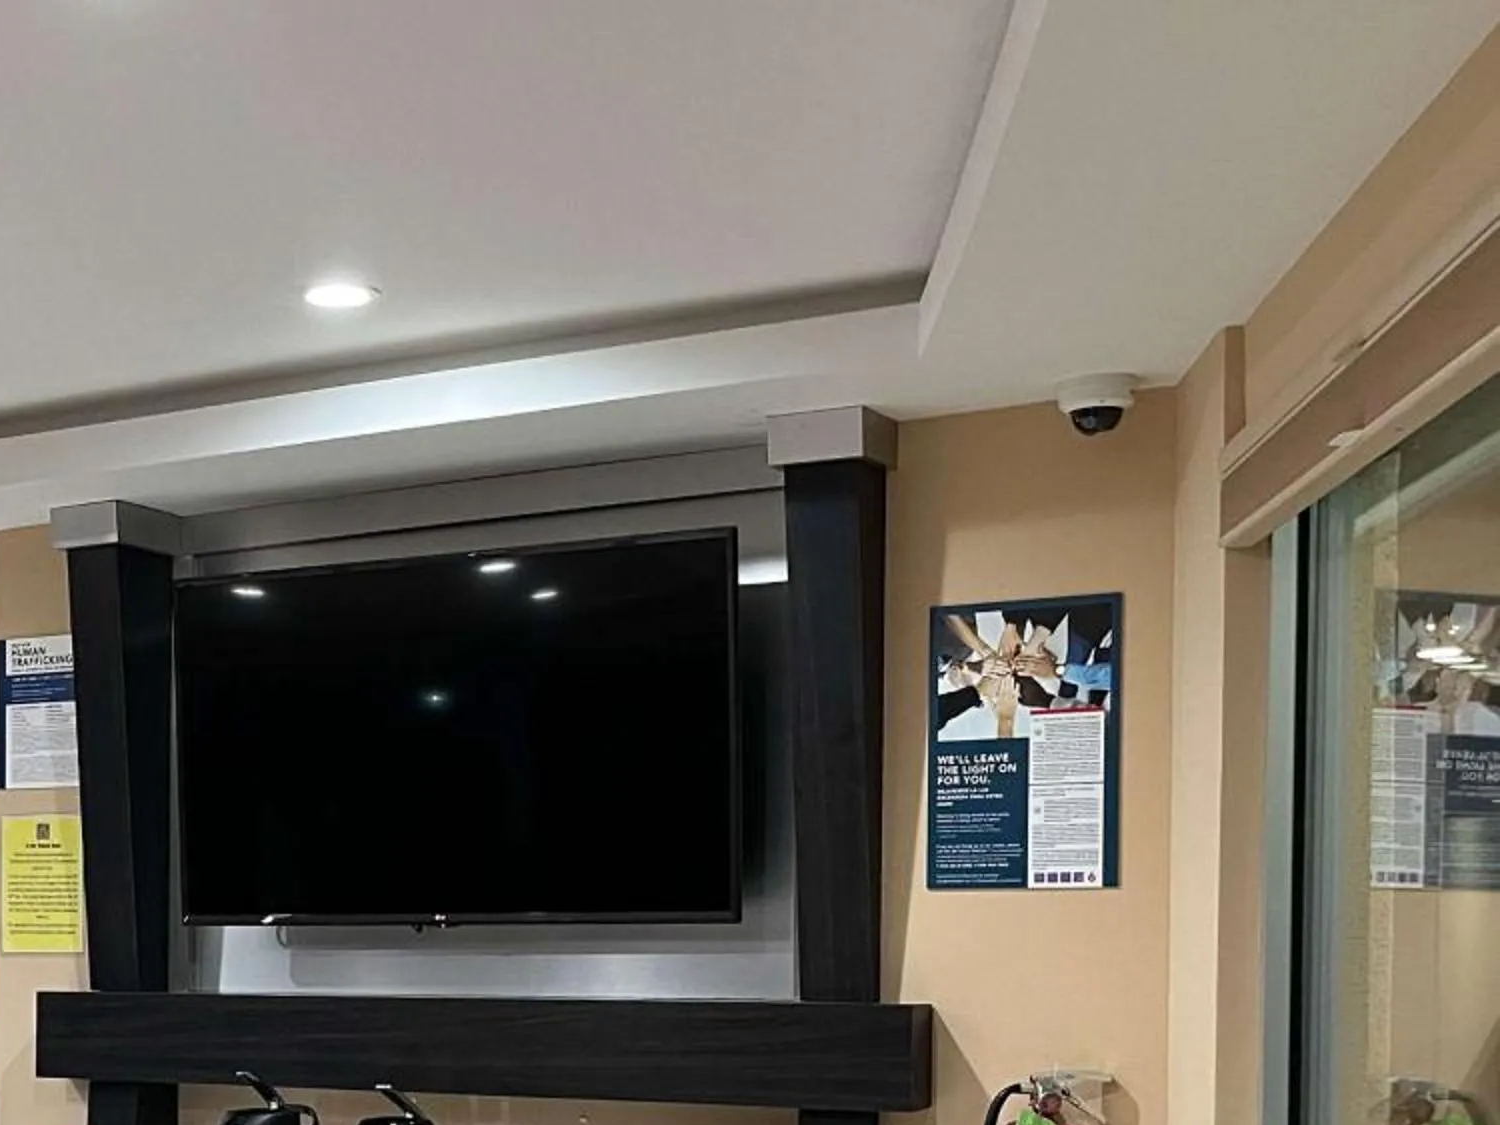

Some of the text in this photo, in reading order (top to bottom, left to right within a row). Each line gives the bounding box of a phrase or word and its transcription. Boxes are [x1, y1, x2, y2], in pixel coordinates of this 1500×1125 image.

[12, 647, 46, 657] HUMAN
[973, 752, 1010, 763] LEAVE
[937, 762, 1017, 775] THE LIGHT ON
[937, 775, 961, 786] FOR
